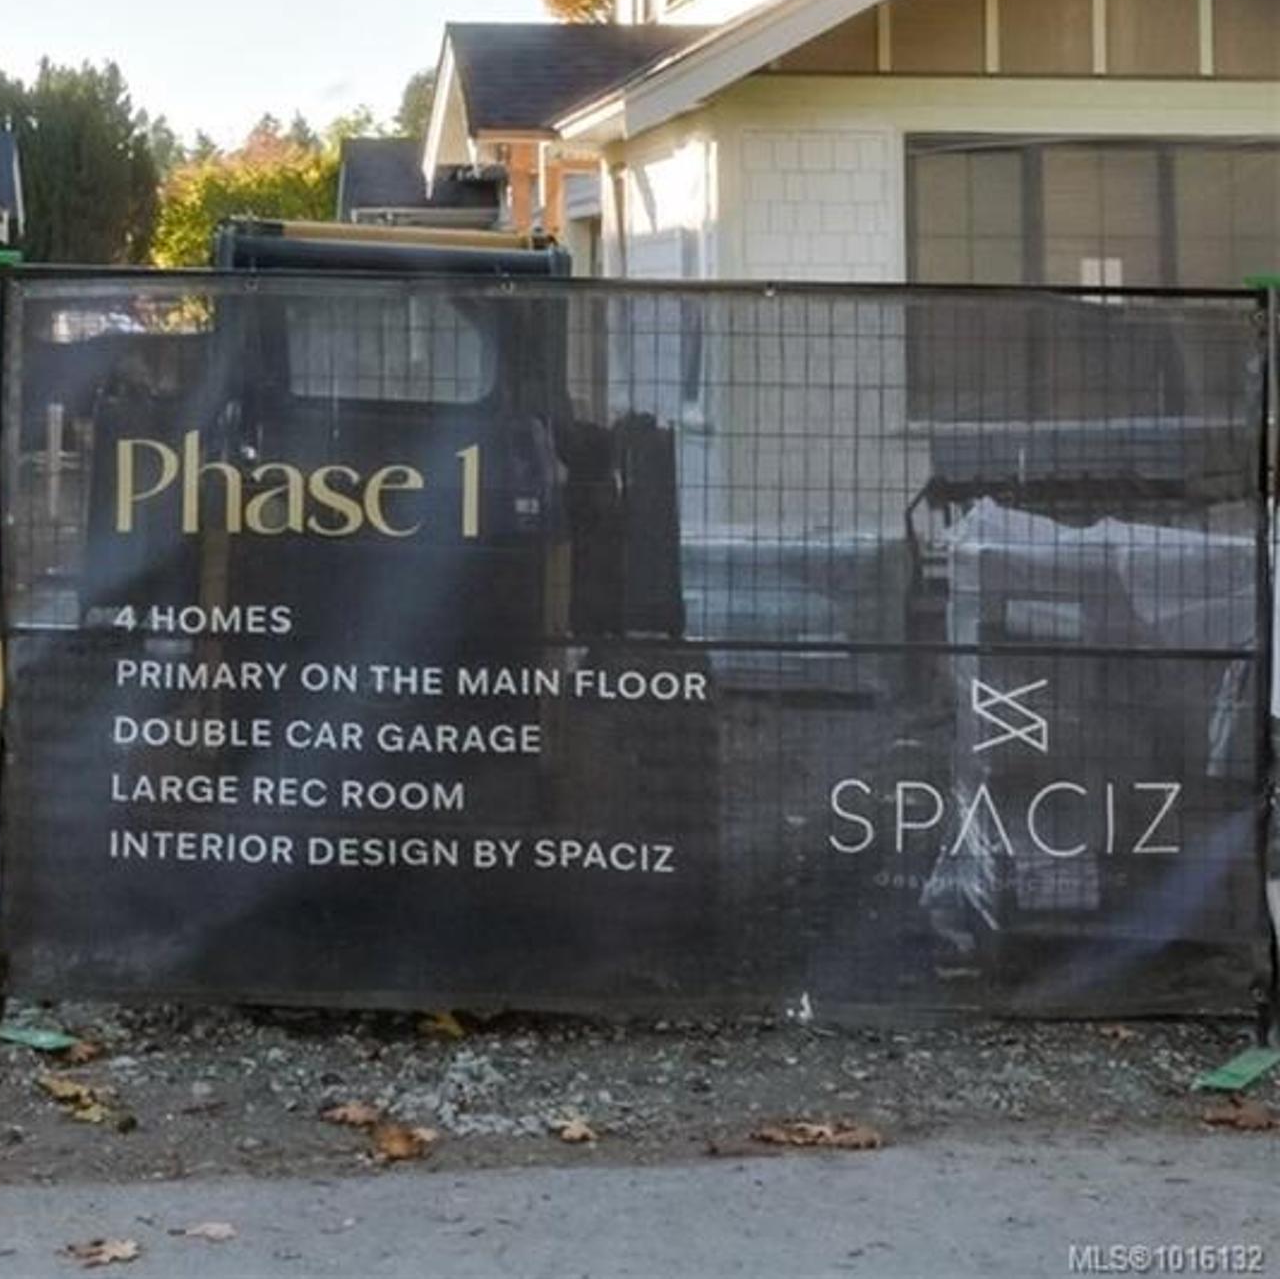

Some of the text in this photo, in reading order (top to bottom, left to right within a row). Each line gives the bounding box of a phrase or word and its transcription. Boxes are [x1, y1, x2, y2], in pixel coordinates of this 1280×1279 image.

[116, 429, 481, 538] Phase 1
[113, 605, 292, 634] 4 HOMES
[116, 659, 707, 701] PRIMARY ON THE MAIN FLOOR
[112, 714, 542, 754] DOUBLE CAR GARAGE
[111, 773, 464, 811] LARGE REC ROOM
[829, 778, 1182, 857] SPACIZ
[110, 830, 675, 873] INTERIOR DESIGN BY SPACIZ
